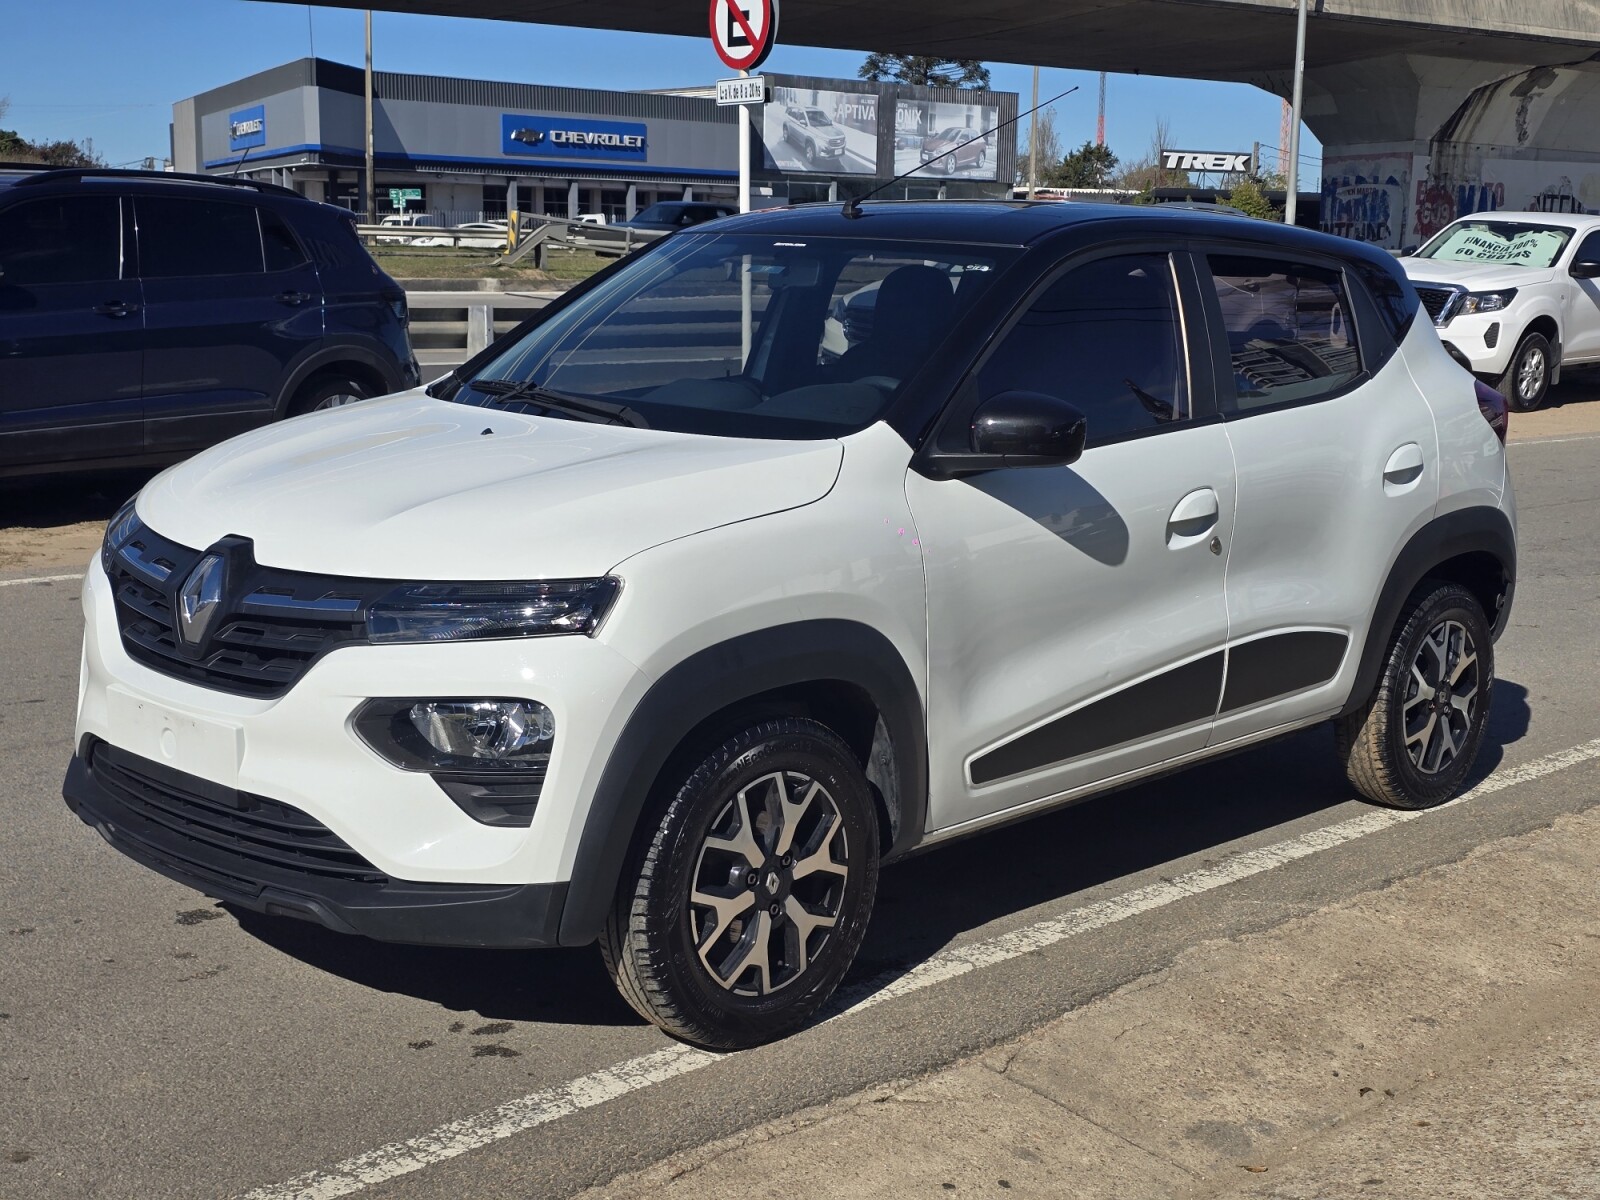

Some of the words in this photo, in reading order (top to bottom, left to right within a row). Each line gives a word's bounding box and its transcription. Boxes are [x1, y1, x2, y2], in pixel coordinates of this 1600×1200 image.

[734, 84, 738, 98] de
[750, 82, 755, 98] 20
[897, 108, 922, 124] ONIX
[549, 130, 645, 148] CHEVROLET
[1163, 152, 1250, 172] TREK
[1464, 236, 1510, 252] FINANCIA
[1512, 238, 1538, 251] 100%
[1476, 250, 1532, 260] CUOTAS
